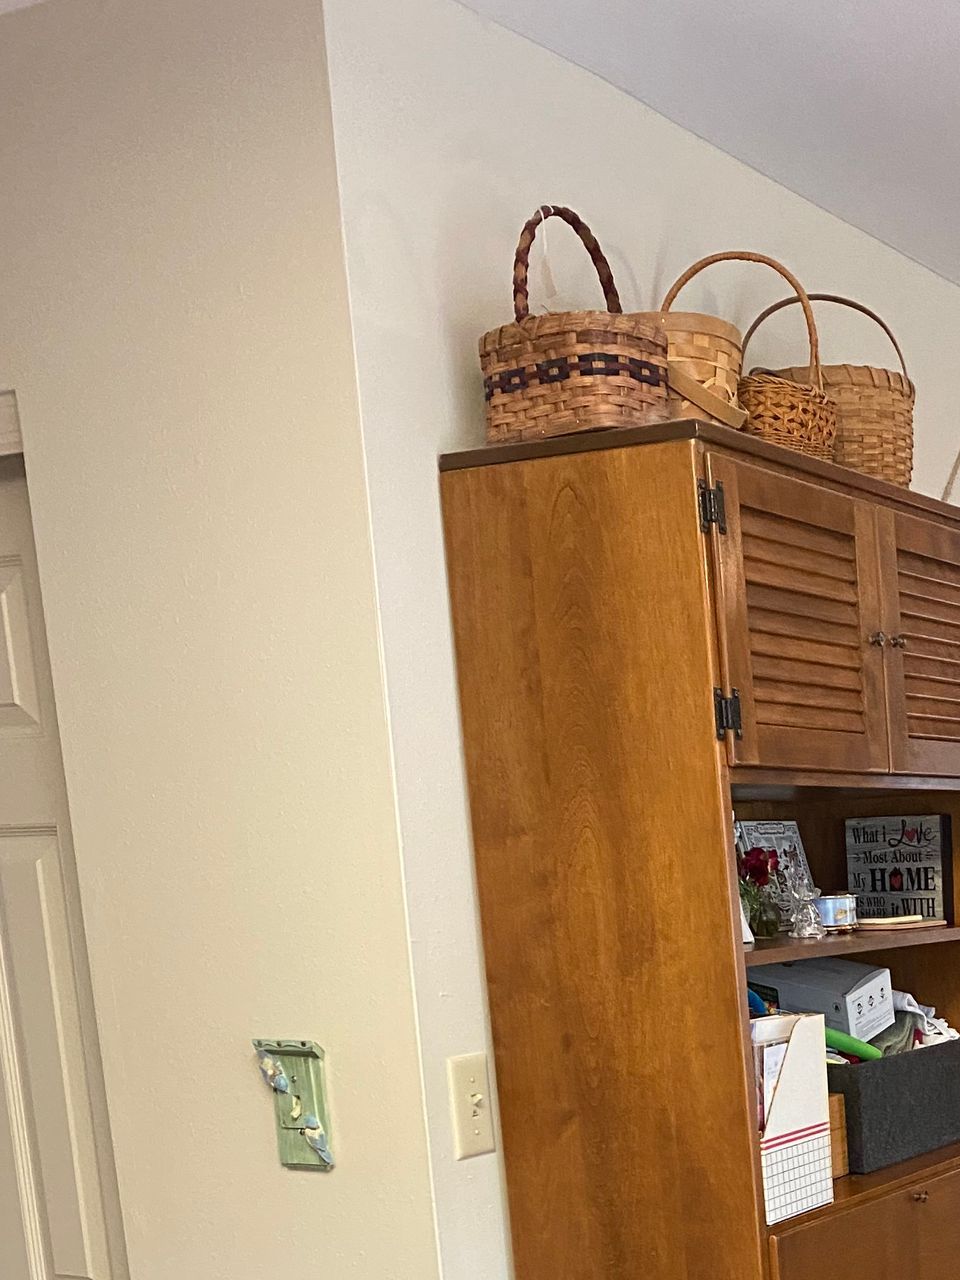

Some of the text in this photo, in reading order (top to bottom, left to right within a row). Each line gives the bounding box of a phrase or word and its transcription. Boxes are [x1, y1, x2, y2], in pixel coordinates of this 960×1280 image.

[852, 825, 879, 844] What
[863, 849, 922, 864] Most About
[852, 866, 937, 892] My HOME
[866, 896, 886, 907] WHO
[891, 897, 936, 918] it WITH
